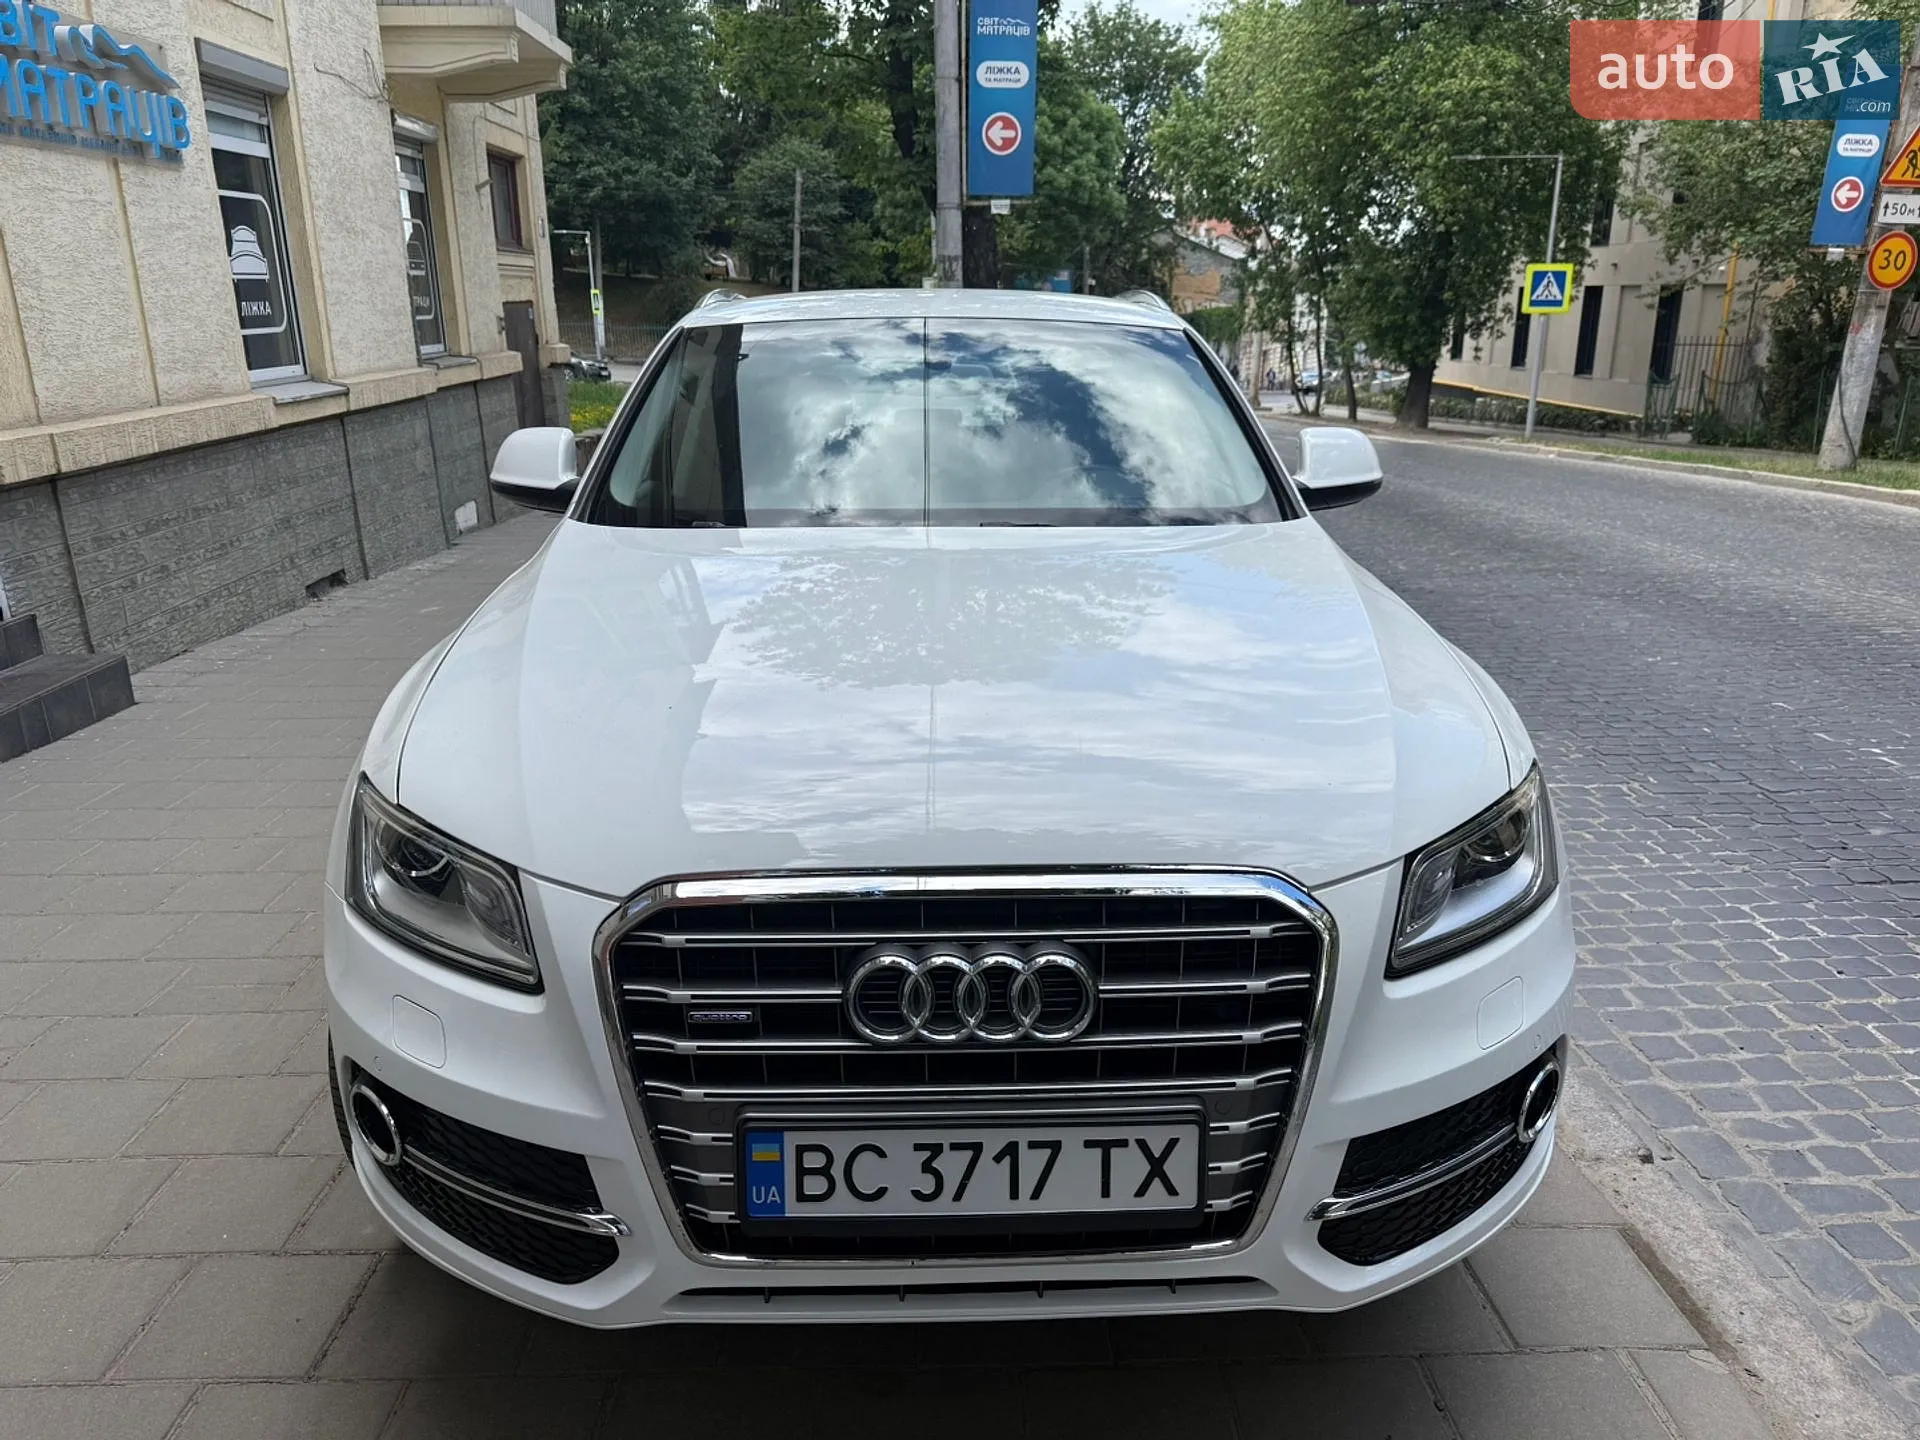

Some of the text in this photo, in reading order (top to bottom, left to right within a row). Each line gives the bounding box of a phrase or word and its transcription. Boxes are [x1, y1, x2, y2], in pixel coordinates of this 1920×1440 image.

[977, 17, 1000, 26] СВІТ
[977, 25, 1031, 37] МАТРАЦІВ
[984, 66, 1021, 75] ЛІЖКА
[1878, 247, 1907, 272] 30
[241, 300, 272, 317] ЛІЖКА
[794, 1137, 1181, 1203] BC 3717 TX
[752, 1184, 782, 1205] UA
